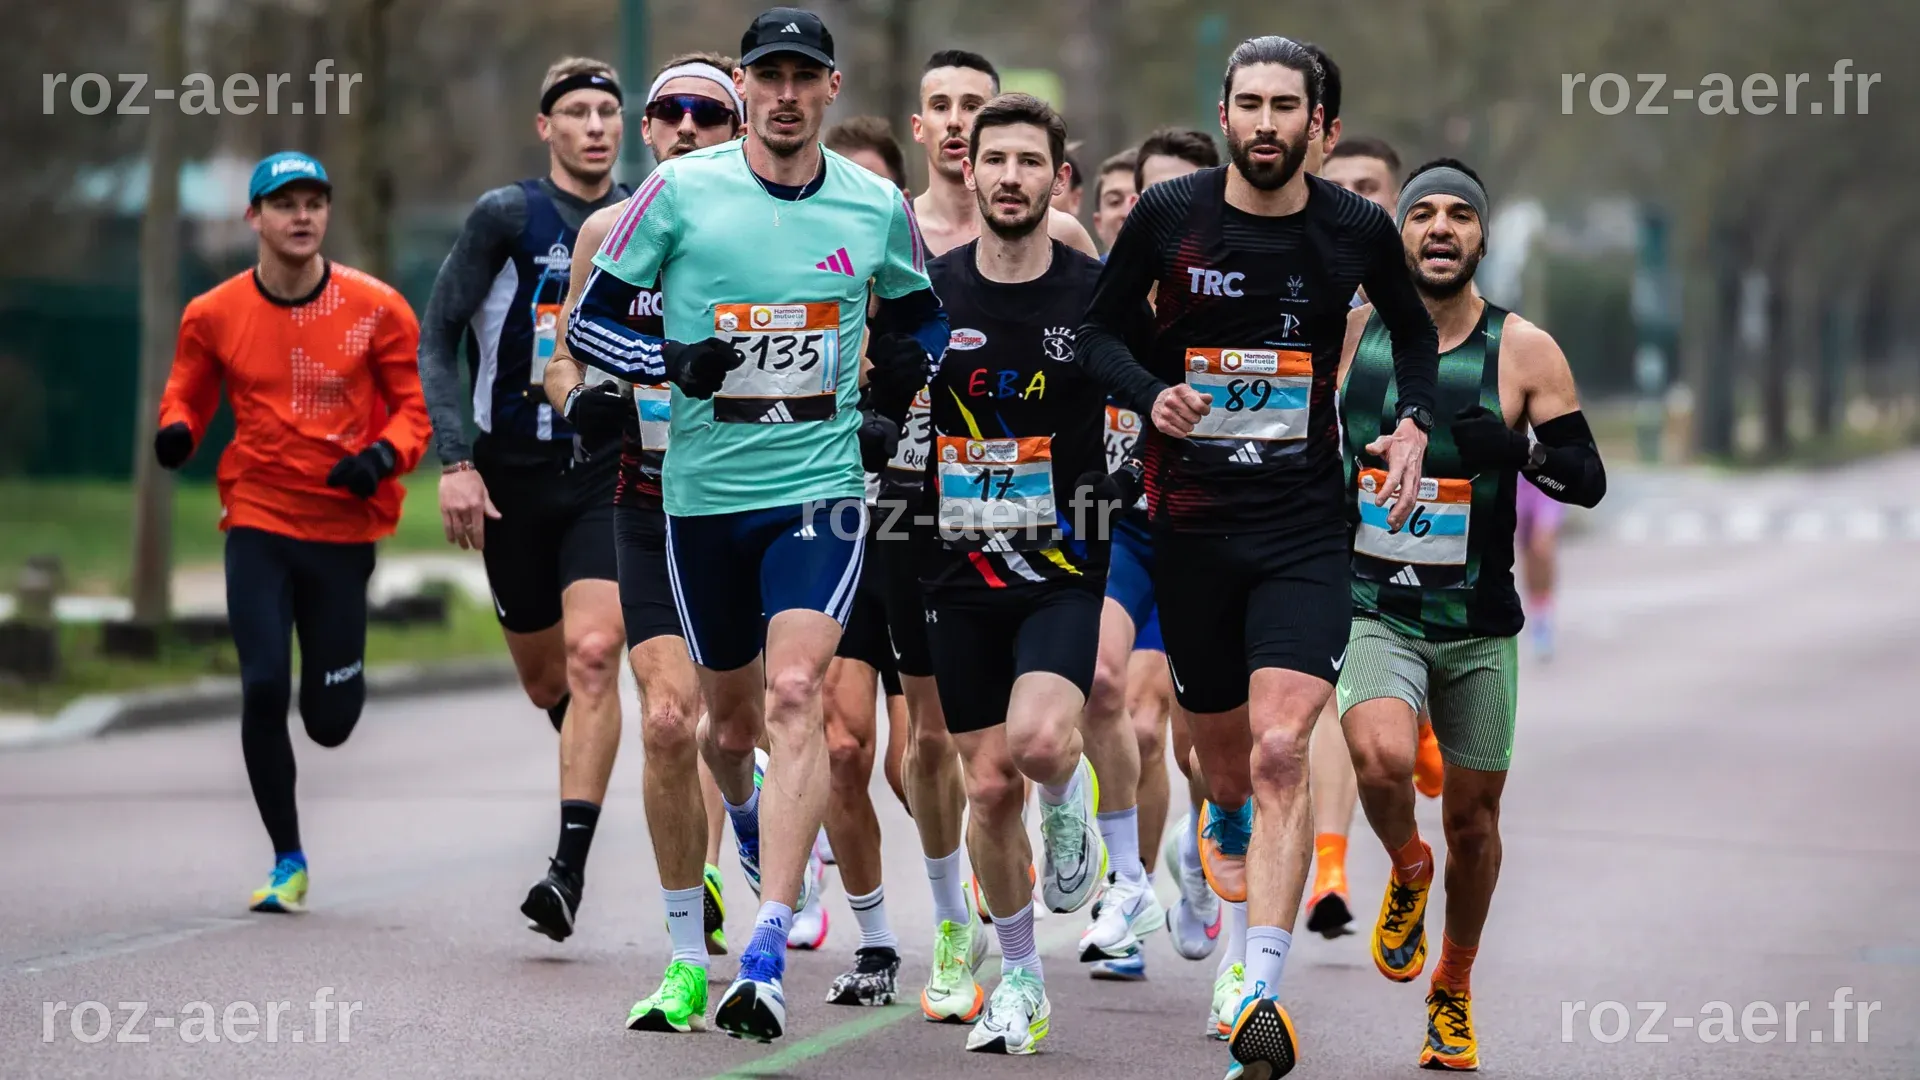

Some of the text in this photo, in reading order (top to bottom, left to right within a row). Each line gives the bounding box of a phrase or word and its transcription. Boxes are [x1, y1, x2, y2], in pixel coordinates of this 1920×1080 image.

[1187, 266, 1246, 298] TRC
[1044, 326, 1077, 341] ALTEA
[730, 335, 823, 371] 5135
[968, 368, 1046, 400] E.B.A
[1225, 379, 1272, 412] 89
[973, 468, 1016, 502] 17
[1536, 474, 1566, 492] KIPRUN
[1387, 504, 1431, 539] 6
[669, 910, 689, 918] RUN
[1262, 947, 1281, 958] RUN
